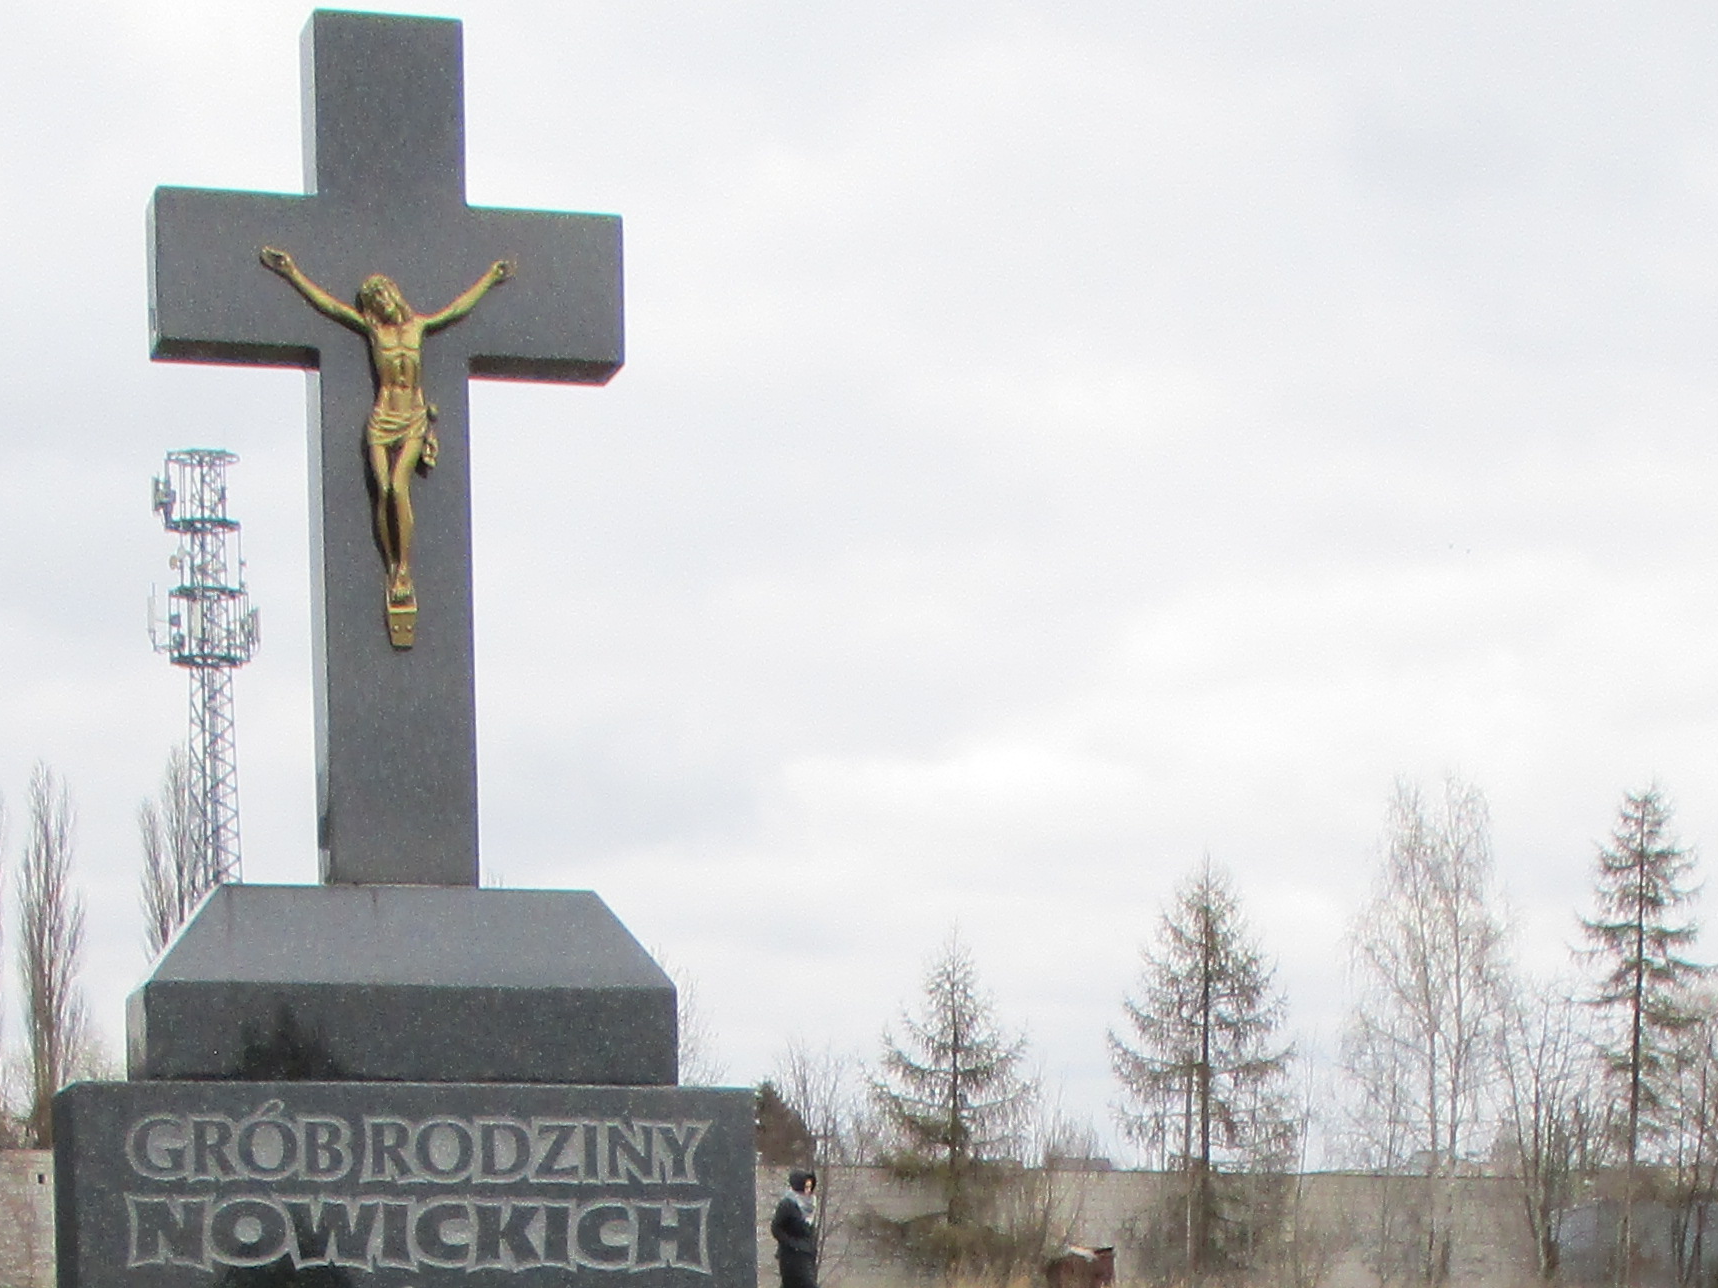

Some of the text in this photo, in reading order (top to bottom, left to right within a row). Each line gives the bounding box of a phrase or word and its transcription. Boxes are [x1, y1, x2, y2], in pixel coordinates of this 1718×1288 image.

[125, 1100, 713, 1186] GRÓB RODZINY
[125, 1193, 713, 1275] NOWICKICH
